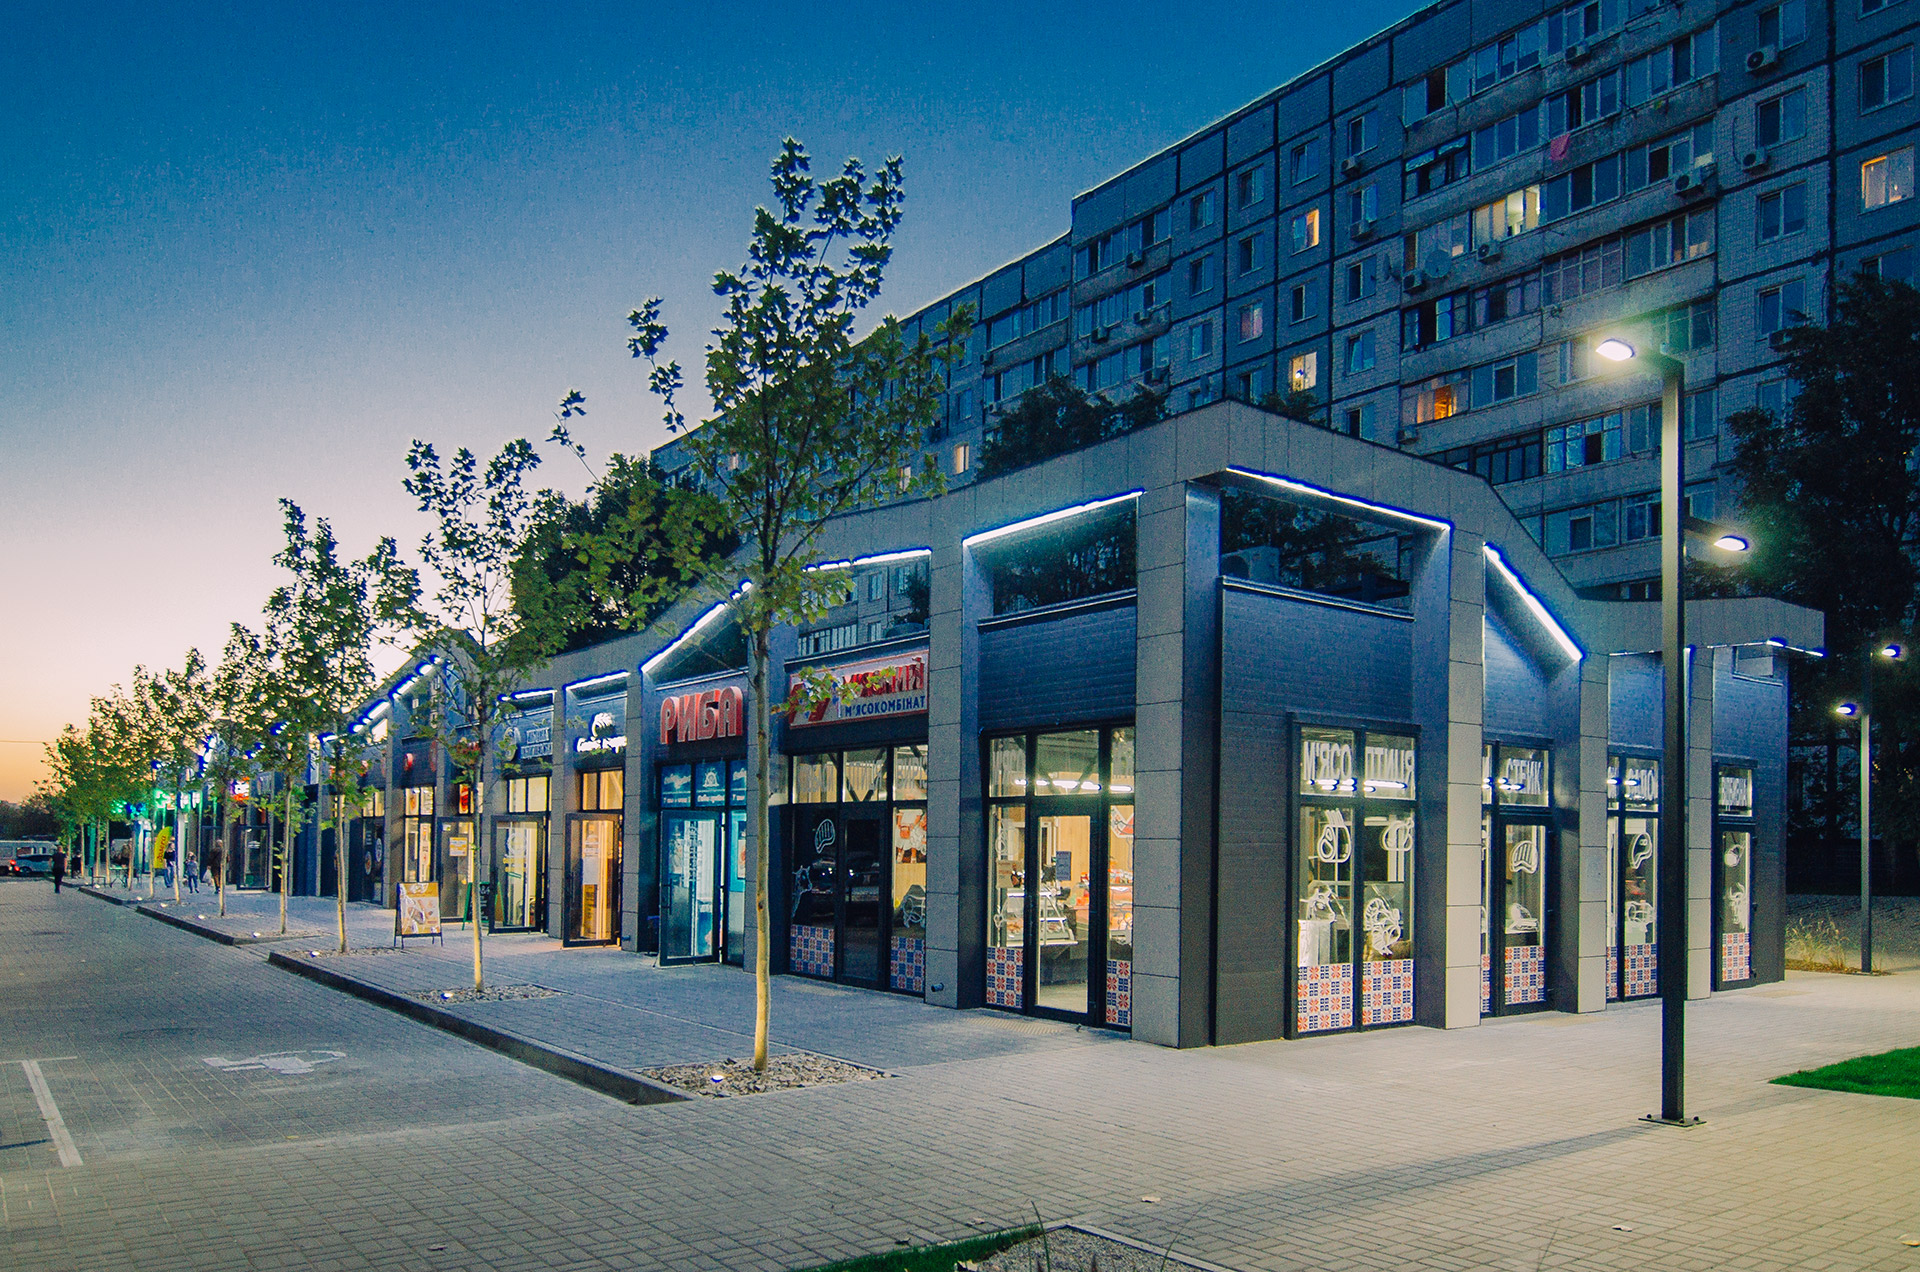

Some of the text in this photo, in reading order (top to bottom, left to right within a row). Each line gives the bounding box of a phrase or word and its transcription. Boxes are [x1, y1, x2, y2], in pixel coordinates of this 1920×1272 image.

[660, 686, 743, 744] РИБА
[844, 695, 926, 717] М'ЯСОКОМБІНАТ
[1303, 740, 1353, 782] М'ЯСО
[1365, 746, 1416, 788] ПТИЦЯ
